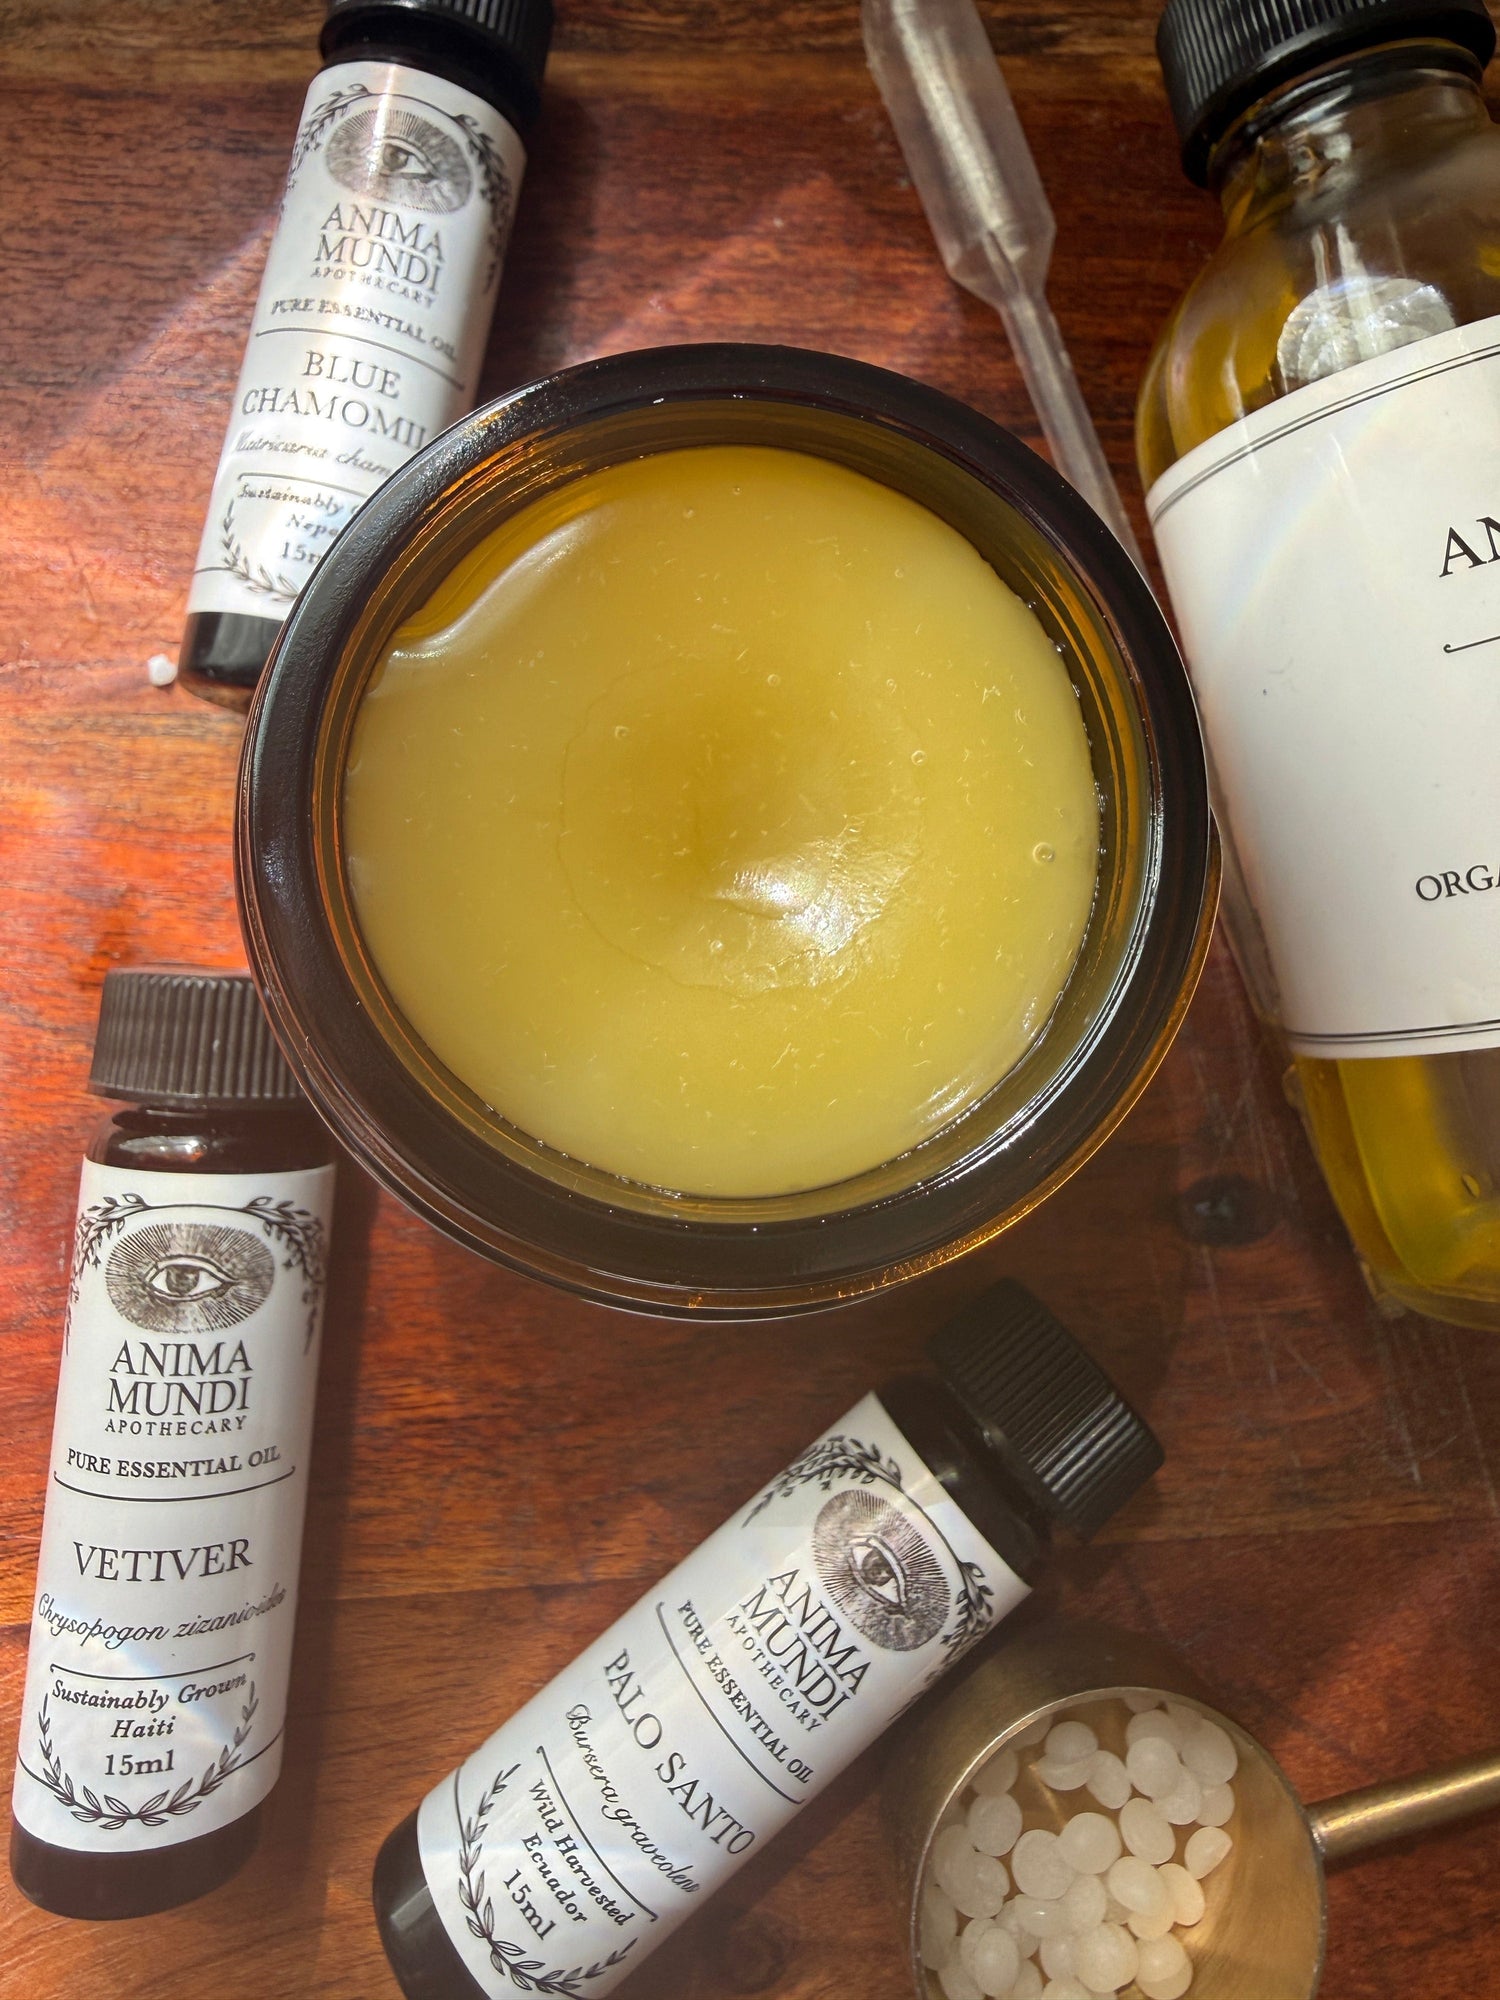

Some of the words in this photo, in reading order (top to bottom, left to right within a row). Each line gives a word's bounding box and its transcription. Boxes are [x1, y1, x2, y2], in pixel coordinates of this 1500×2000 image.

[322, 203, 446, 262] ANIMA
[310, 267, 437, 308] APOTHECARY
[314, 234, 442, 294] MUNDI
[302, 350, 400, 399] BLUE
[238, 483, 344, 517] Sustainably
[1416, 865, 1500, 901] ORG
[109, 1340, 253, 1377] ANIMA
[106, 1377, 252, 1417] MUNDI
[105, 1415, 248, 1436] APOTHECARY
[67, 1448, 111, 1475] PURE
[116, 1455, 242, 1479] ESSENTIAL
[248, 1446, 281, 1467] OIL
[73, 1538, 253, 1582] VETIVER
[39, 1593, 167, 1649] Chrysopogon
[767, 1568, 871, 1695] ANIMA
[726, 1614, 823, 1732] APOTHECARY
[739, 1583, 851, 1721] MUNDI
[52, 1680, 170, 1713] Sustainably
[178, 1673, 248, 1704] Grown
[677, 1599, 708, 1656] PURE
[705, 1652, 789, 1763] ESSENTIAL
[787, 1759, 817, 1784] OIL
[111, 1716, 177, 1738] Haiti
[603, 1648, 662, 1750] PALO
[655, 1752, 755, 1855] SANTO
[104, 1750, 175, 1776] 15ml
[566, 1703, 619, 1804] Bursera
[602, 1803, 700, 1894] graveolens
[521, 1832, 588, 1923] Ecuador
[528, 1778, 563, 1834] Wild
[554, 1833, 635, 1926] Harvested
[502, 1868, 557, 1941] 15ml
